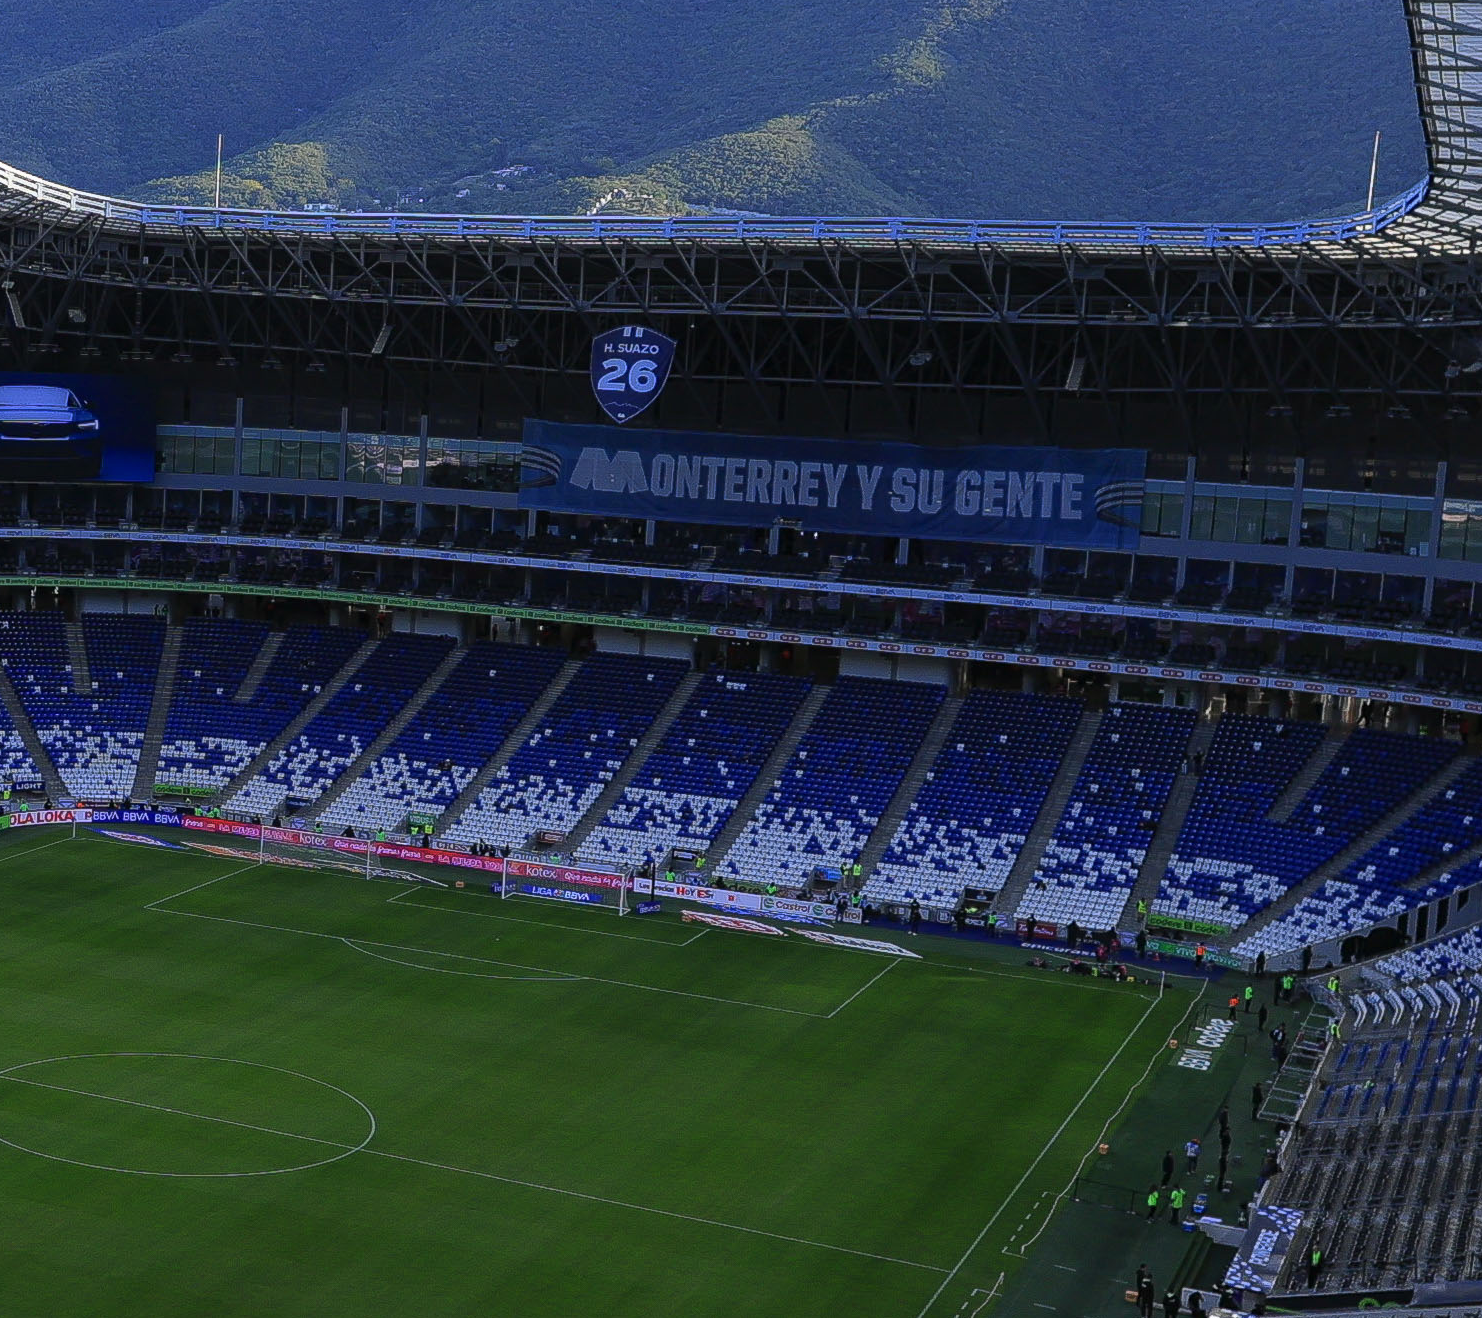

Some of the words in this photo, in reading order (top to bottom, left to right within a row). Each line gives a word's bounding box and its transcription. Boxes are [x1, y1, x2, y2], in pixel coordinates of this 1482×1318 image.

[604, 343, 615, 353] H.
[617, 343, 659, 355] SUAZO
[597, 358, 658, 393] 26
[857, 464, 883, 510] Y
[890, 468, 942, 514] SU
[955, 470, 1084, 520] GENTE
[36, 810, 74, 823] LOKA
[94, 810, 119, 820] BBVA
[123, 811, 150, 822] BBVA
[155, 813, 180, 824] BBVA
[526, 864, 557, 878] kotex
[532, 886, 553, 897] LIGA
[565, 890, 590, 901] BBVA
[776, 900, 811, 913] Castrol
